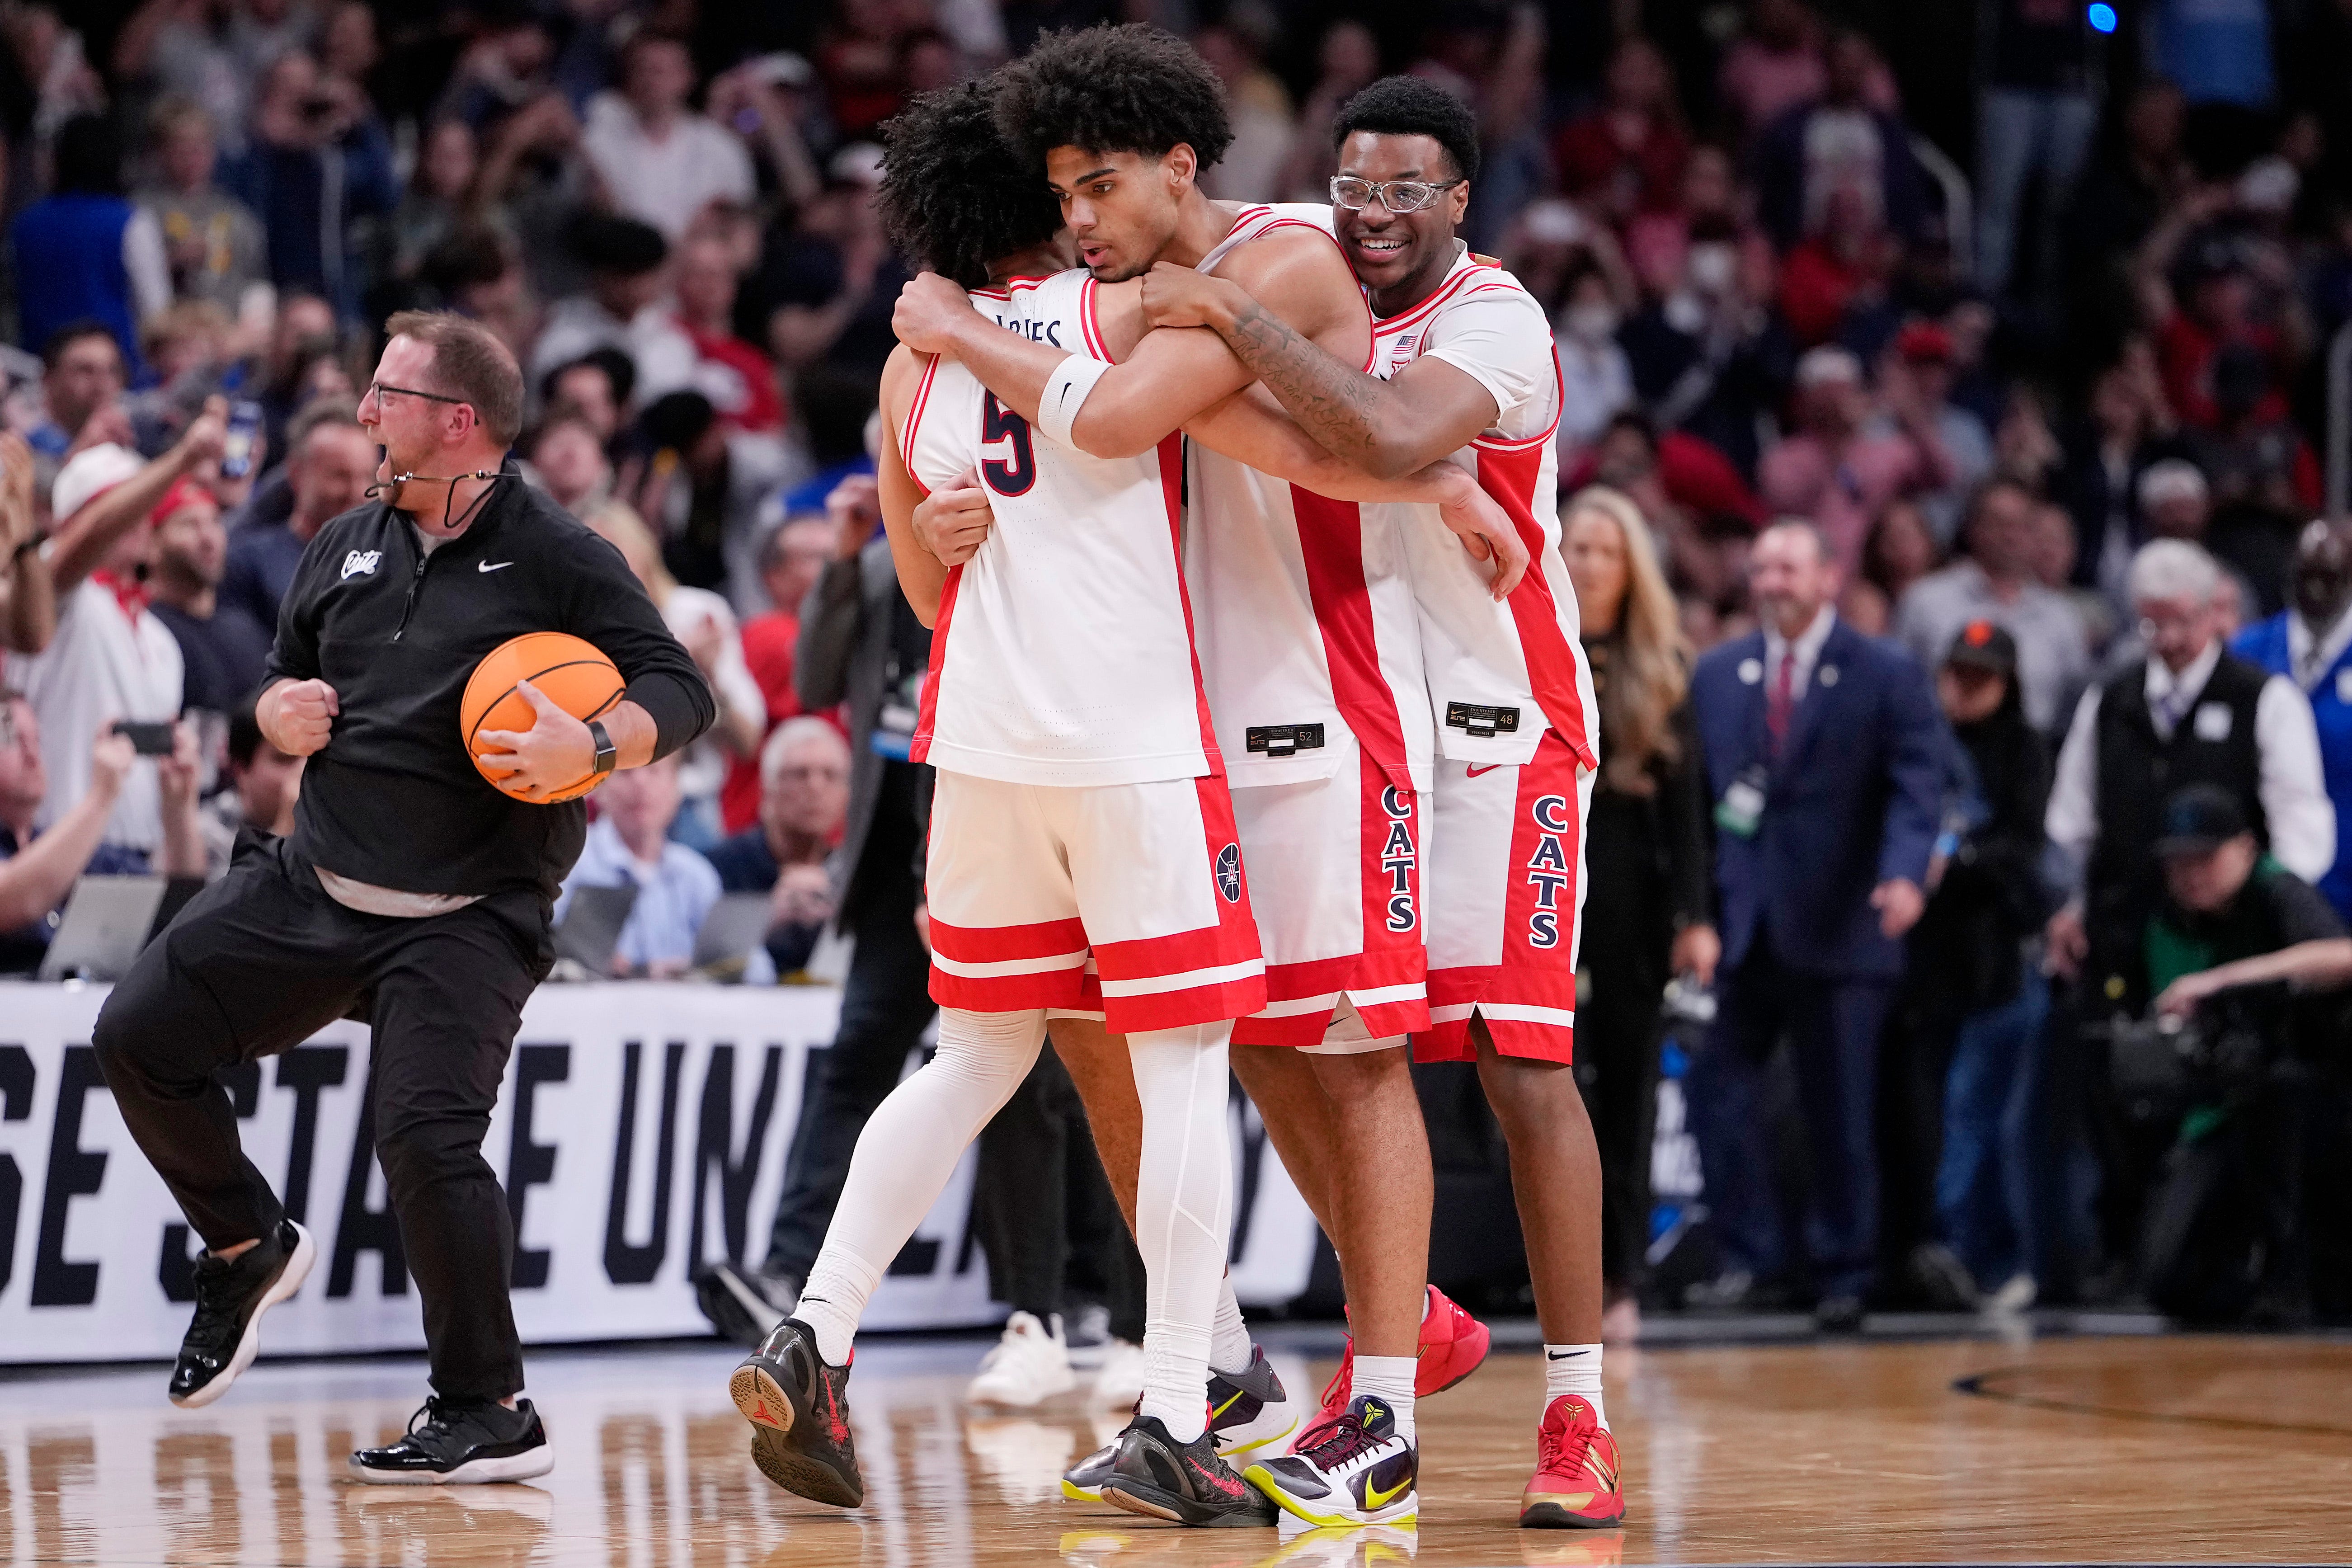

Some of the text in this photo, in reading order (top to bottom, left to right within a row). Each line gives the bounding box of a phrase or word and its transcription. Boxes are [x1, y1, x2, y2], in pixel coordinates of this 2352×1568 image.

[982, 387, 1036, 497] 5
[1299, 732, 1312, 741] 52
[1500, 715, 1513, 725] 48
[1381, 783, 1416, 932] CATS
[1527, 794, 1568, 949] CATS
